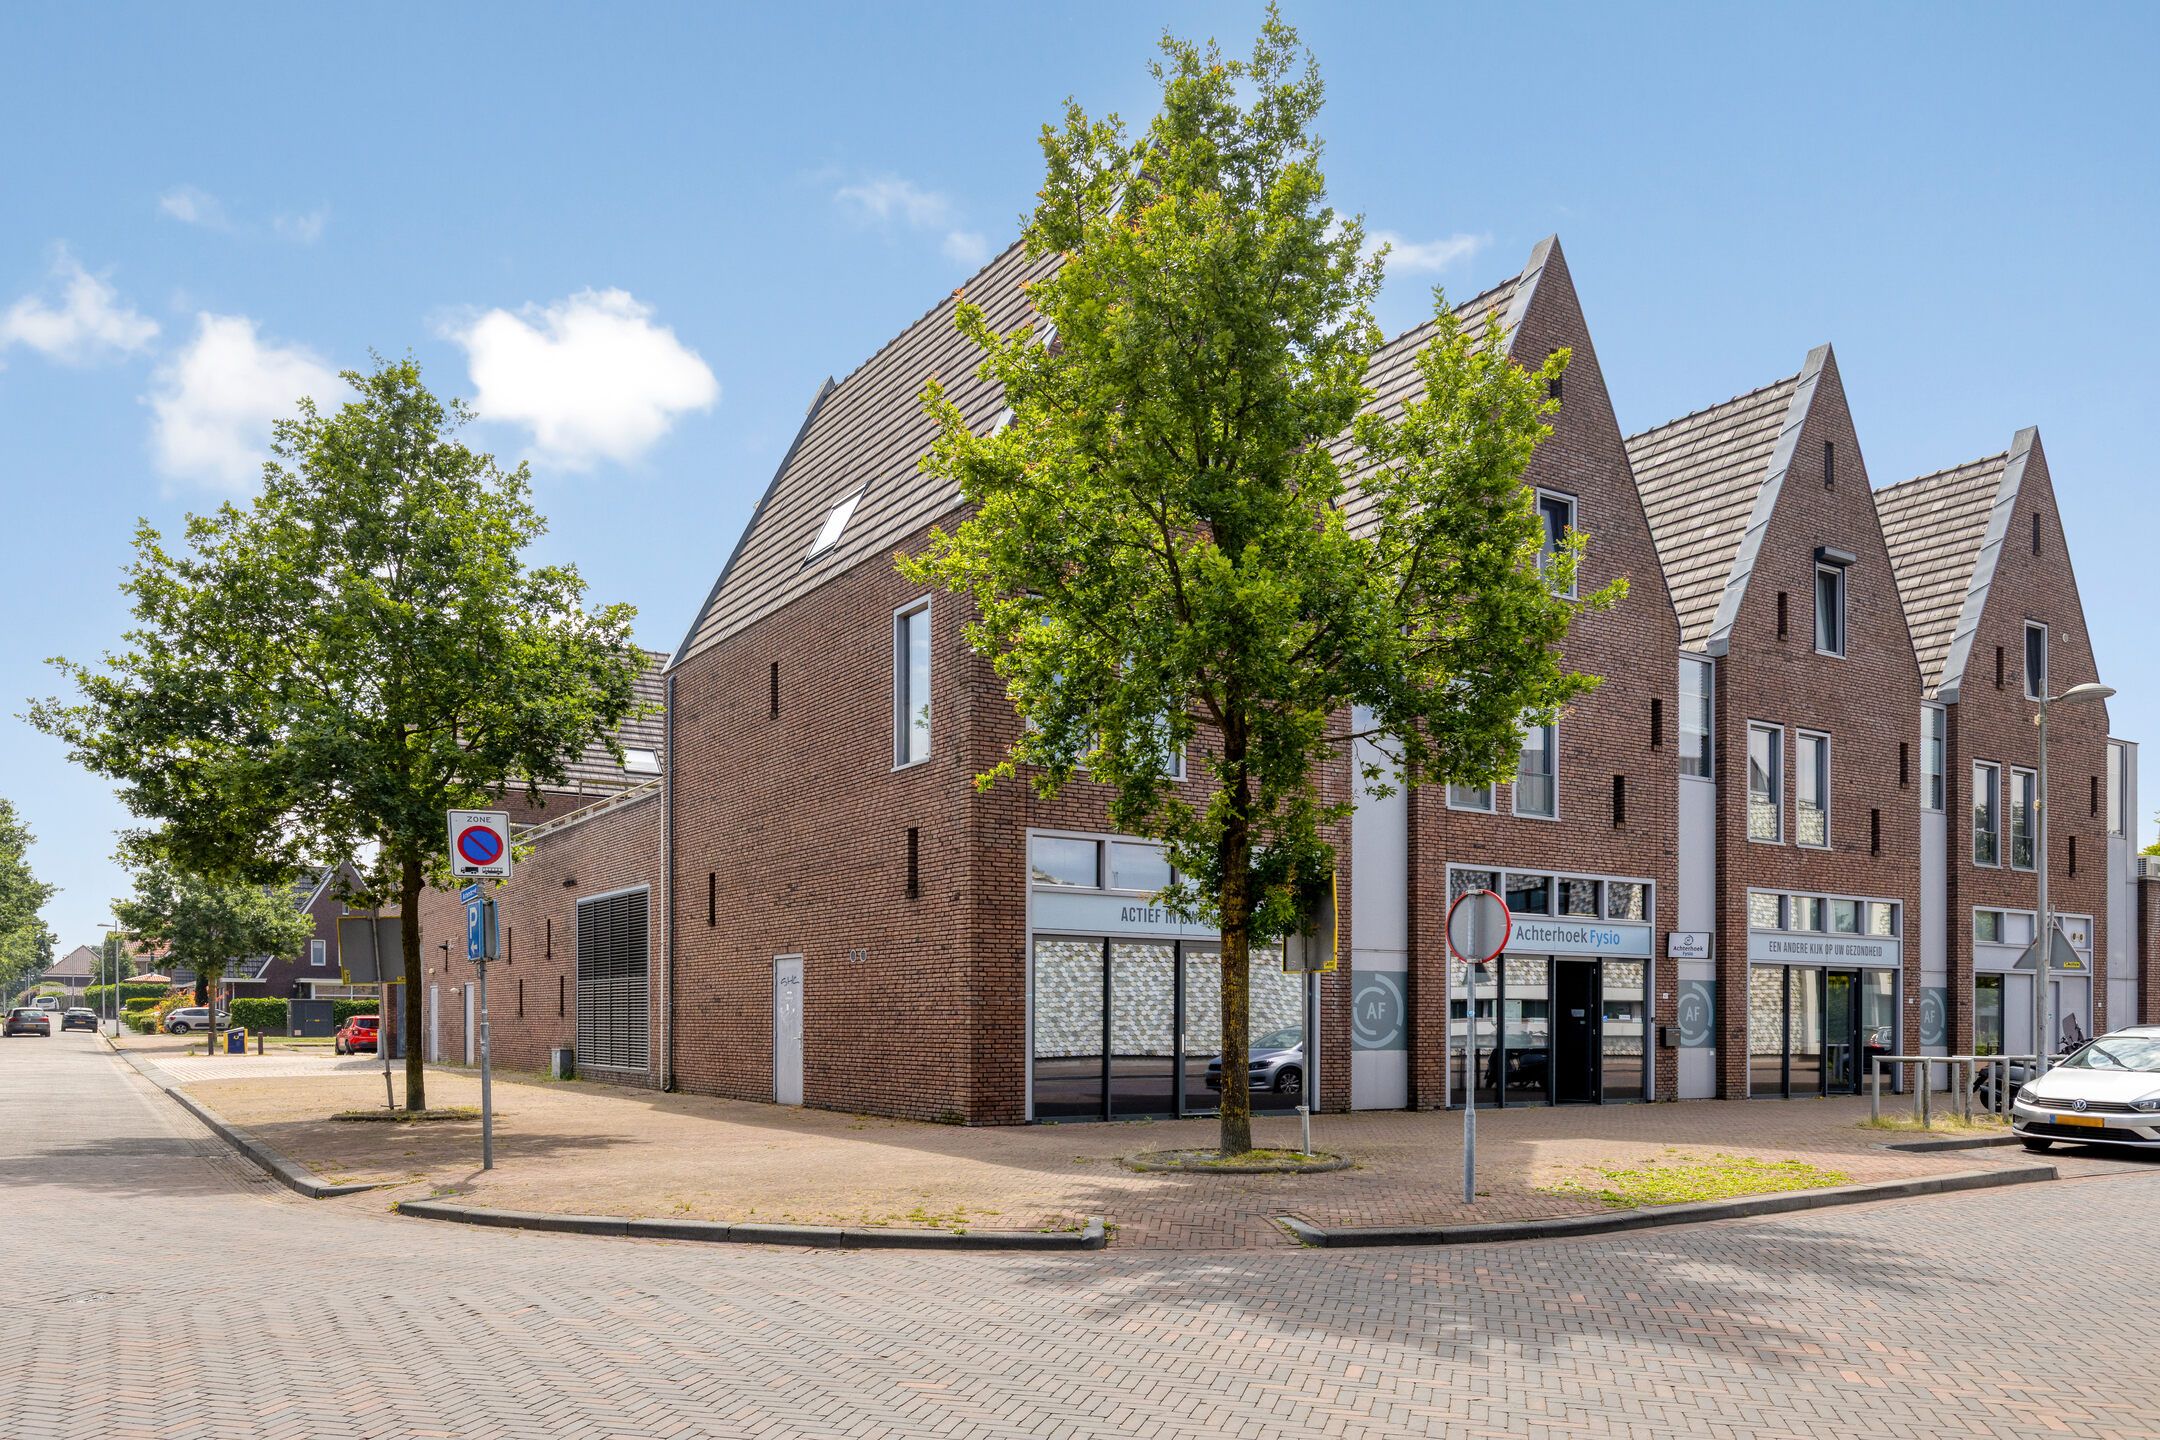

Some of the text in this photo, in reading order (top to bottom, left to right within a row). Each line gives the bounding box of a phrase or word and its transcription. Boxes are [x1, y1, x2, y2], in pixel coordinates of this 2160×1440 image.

[469, 907, 478, 939] P
[1121, 907, 1161, 923] ACTIEF
[1165, 909, 1177, 924] IN
[1516, 925, 1621, 947] Achterhoek Fysio
[1769, 941, 1882, 956] EEN ANDERE KIJK OP UW GEZONDHEID
[1366, 1002, 1386, 1019] AF
[1686, 1006, 1700, 1021] AF
[1924, 1010, 1935, 1023] AF
